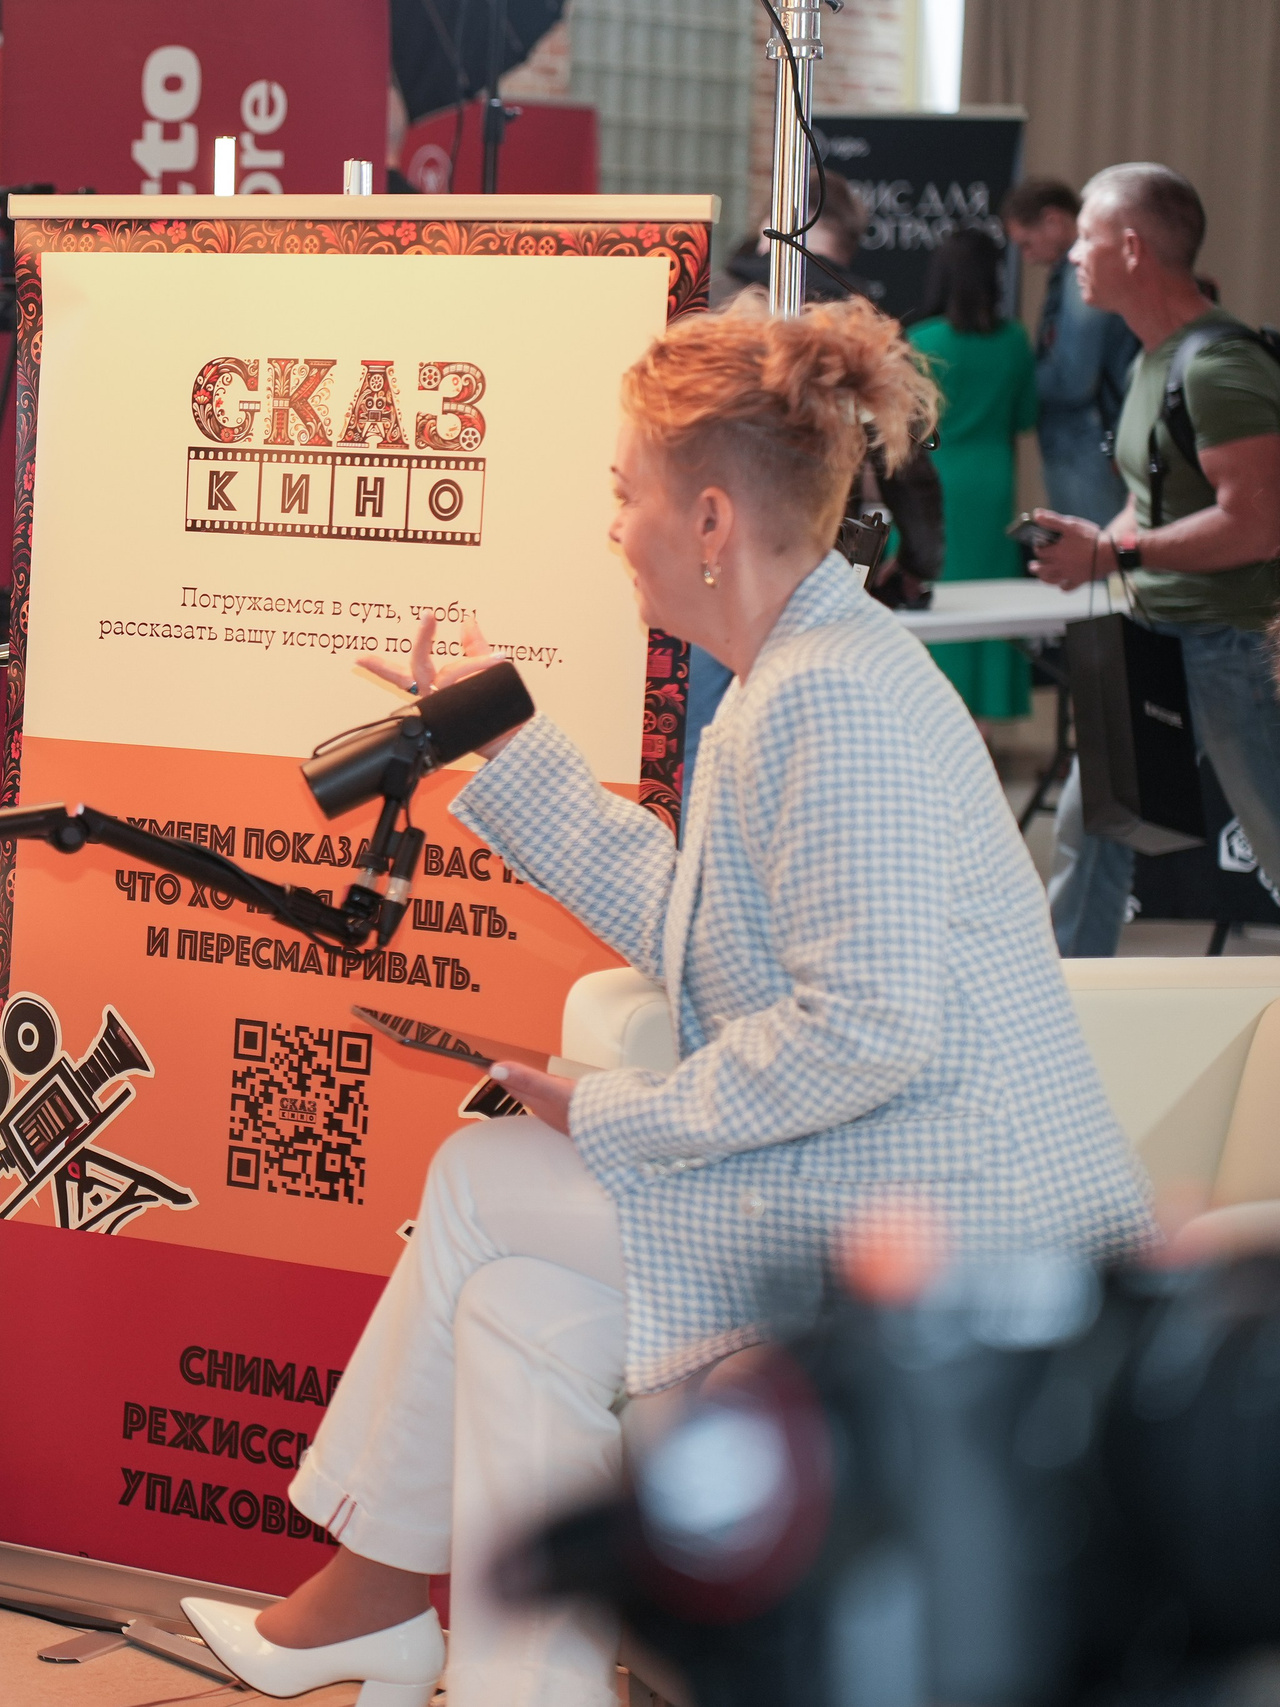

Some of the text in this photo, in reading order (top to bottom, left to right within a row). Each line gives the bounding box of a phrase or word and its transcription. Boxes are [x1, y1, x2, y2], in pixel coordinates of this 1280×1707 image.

[131, 45, 202, 194] to
[191, 356, 487, 452] СКАЗ
[207, 470, 464, 522] КИНО
[181, 586, 324, 616] Погружаемся
[331, 601, 342, 616] в
[349, 601, 402, 624] суть,
[98, 619, 218, 640] рассказать
[224, 626, 276, 650] вашу
[282, 630, 379, 654] историю
[243, 827, 377, 869] ПОКАЗА
[424, 843, 492, 882] ВАС
[115, 869, 182, 906] ЧТО
[146, 925, 481, 993] И ПЕРЕСМАТРИВАТЬ.
[279, 1097, 317, 1113] СКАЗ
[122, 1400, 313, 1471] РЕЖИСС
[118, 1466, 341, 1547] УПАКОВЫ
